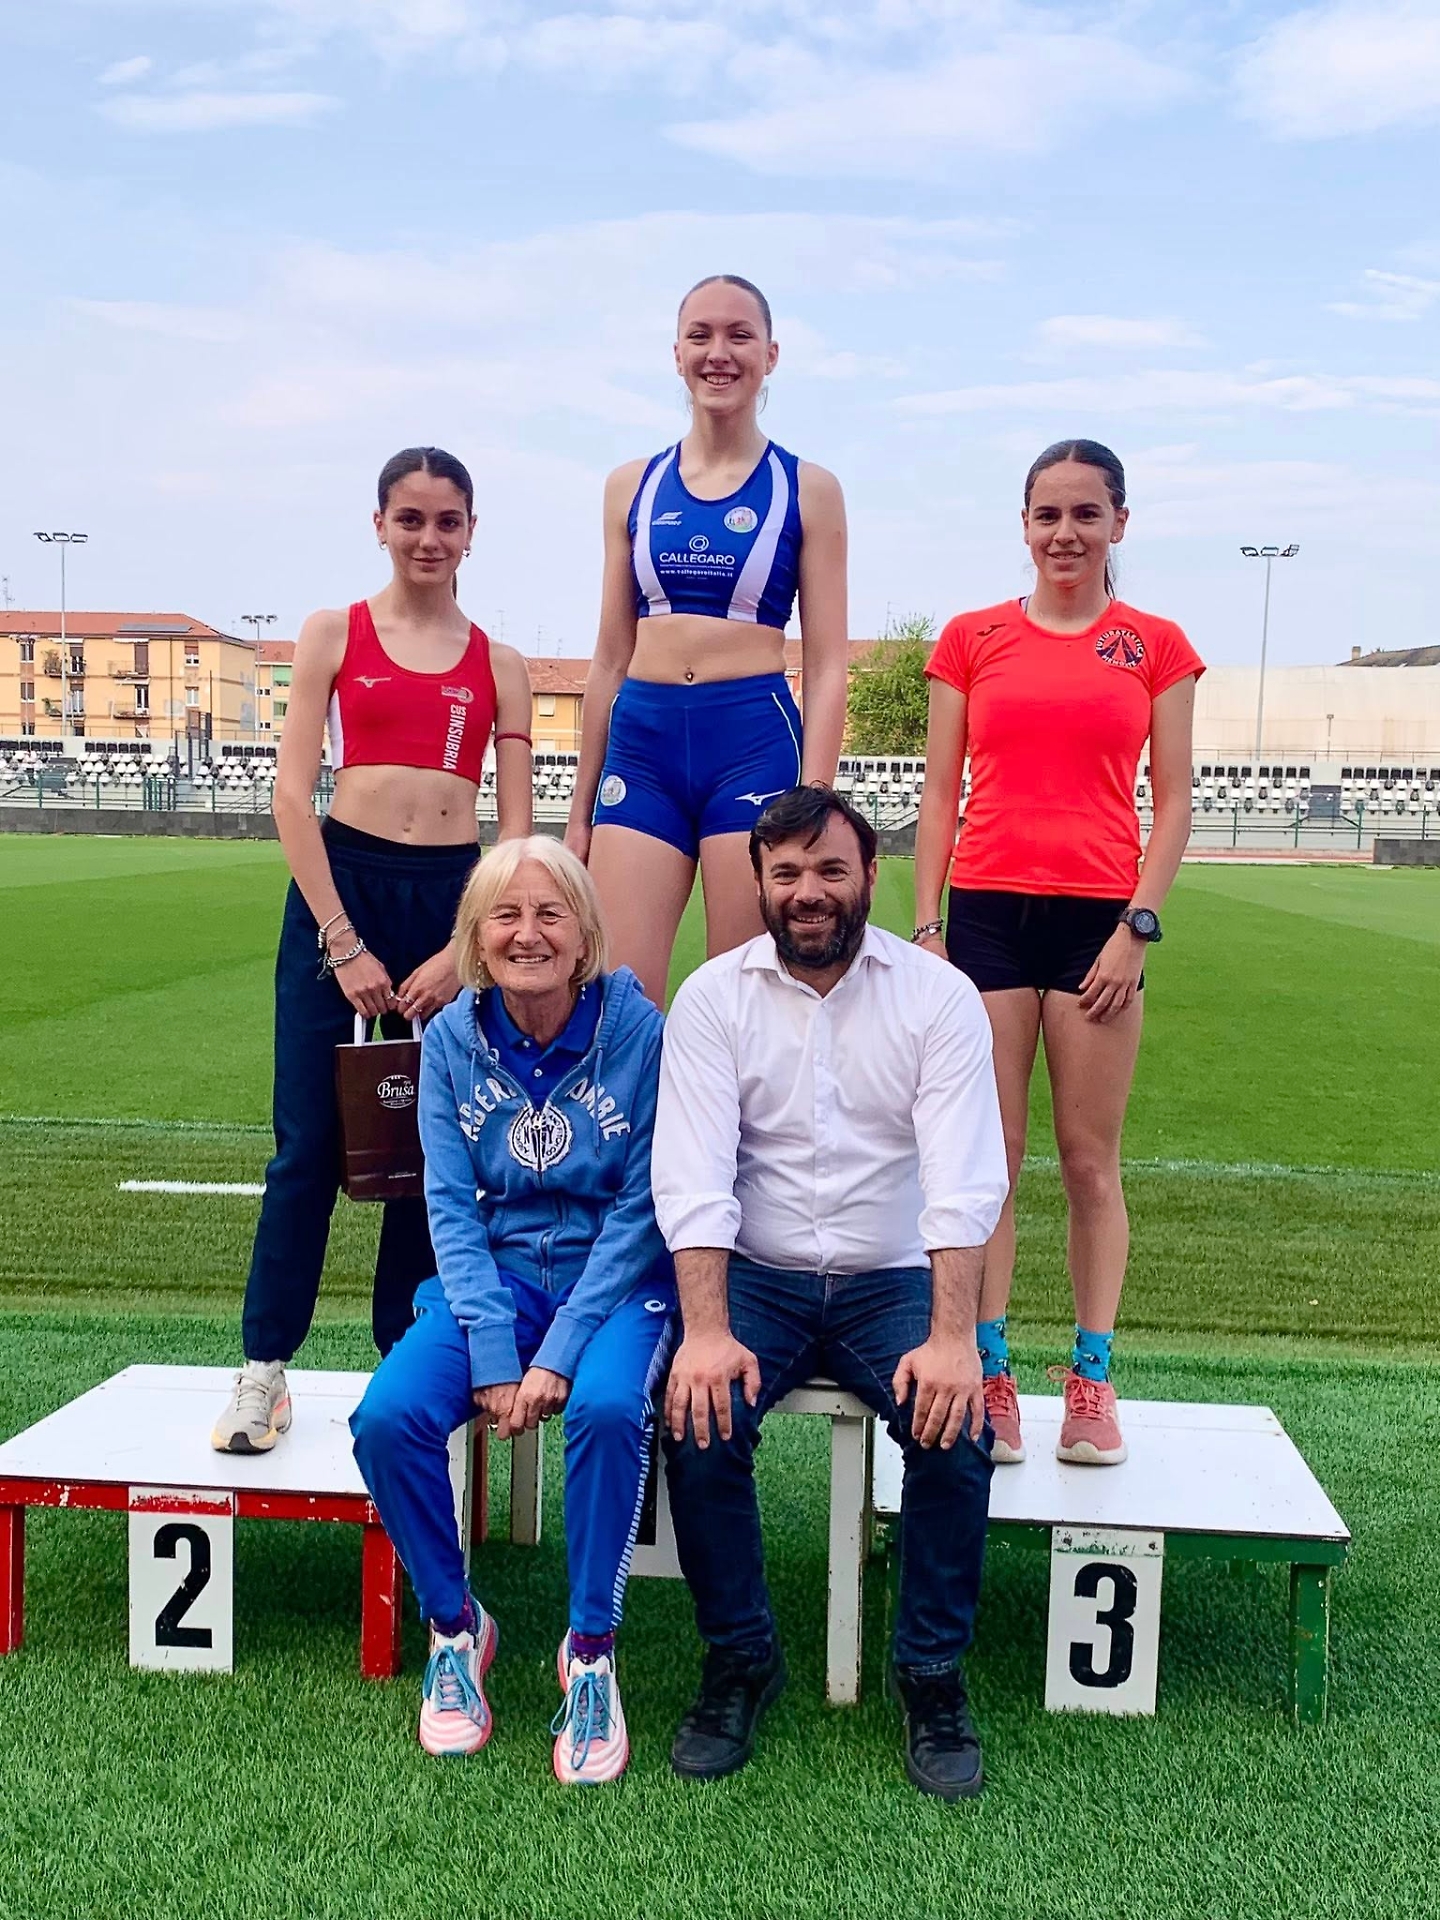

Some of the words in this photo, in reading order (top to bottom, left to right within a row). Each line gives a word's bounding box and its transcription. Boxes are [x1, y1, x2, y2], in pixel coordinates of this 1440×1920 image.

[659, 552, 735, 565] CALLEGARO
[1096, 629, 1144, 658] FUTURATLETICA
[442, 714, 466, 770] INSUBRIA
[377, 1081, 414, 1098] Brusa
[154, 1523, 212, 1648] 2
[1069, 1562, 1138, 1688] 3
